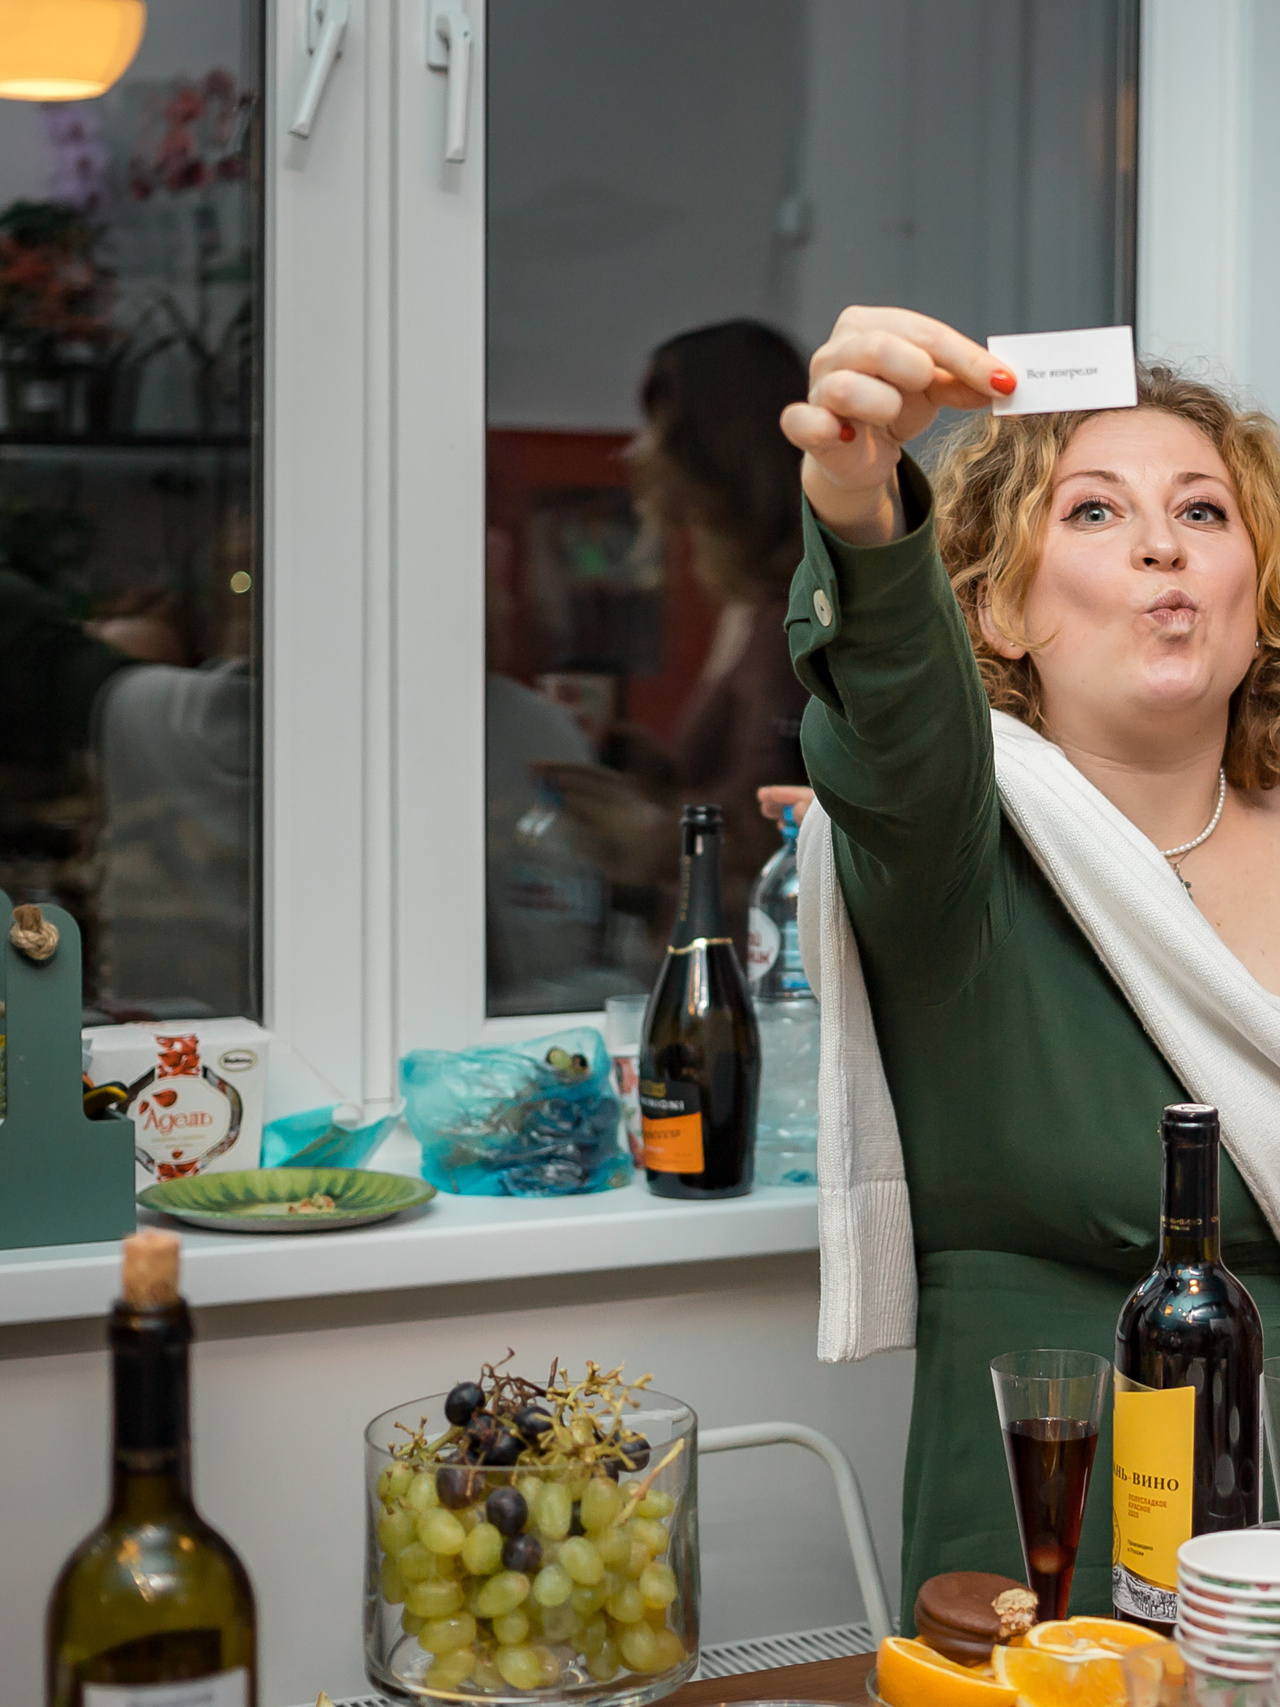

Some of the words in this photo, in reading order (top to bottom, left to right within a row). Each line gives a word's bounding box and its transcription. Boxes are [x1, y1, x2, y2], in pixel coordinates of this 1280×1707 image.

[1026, 368, 1046, 380] Все
[1128, 1493, 1168, 1508] ПОЛУСЛАДКОЕ
[1128, 1502, 1151, 1513] КРАСНОЕ
